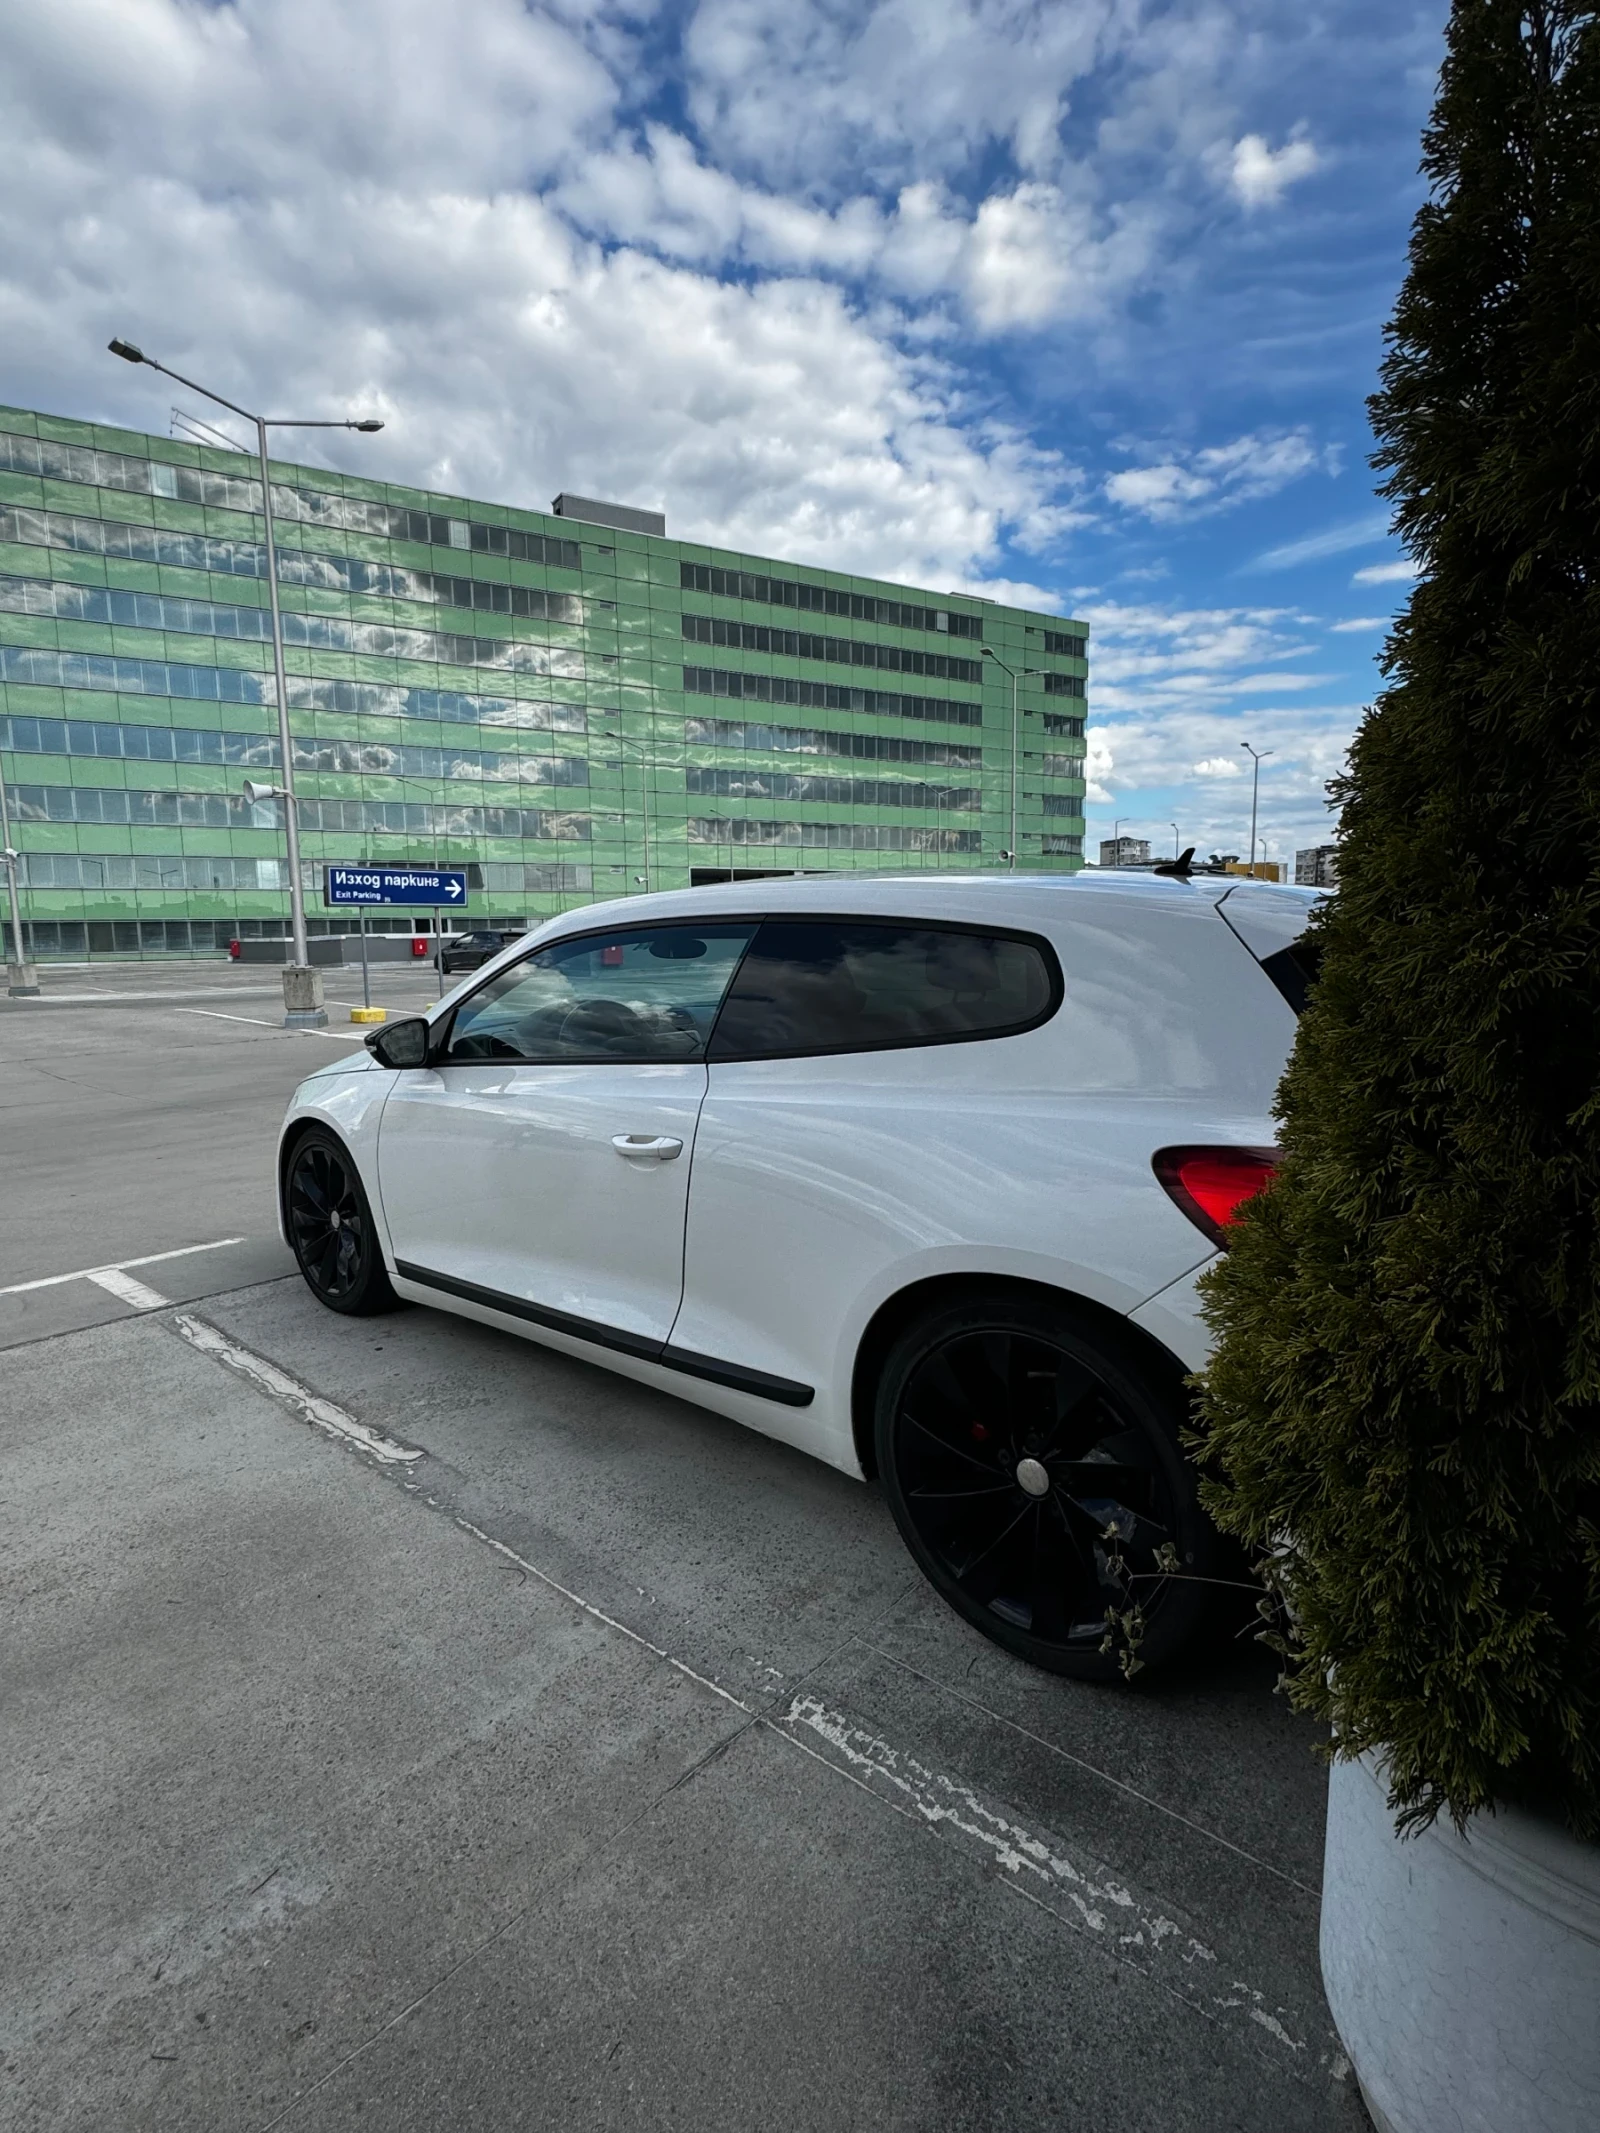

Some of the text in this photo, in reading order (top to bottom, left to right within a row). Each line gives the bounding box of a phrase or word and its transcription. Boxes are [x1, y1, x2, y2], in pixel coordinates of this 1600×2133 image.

[335, 871, 440, 889] Изход паркинг
[335, 890, 351, 899] Exit
[353, 891, 381, 901] Parking
